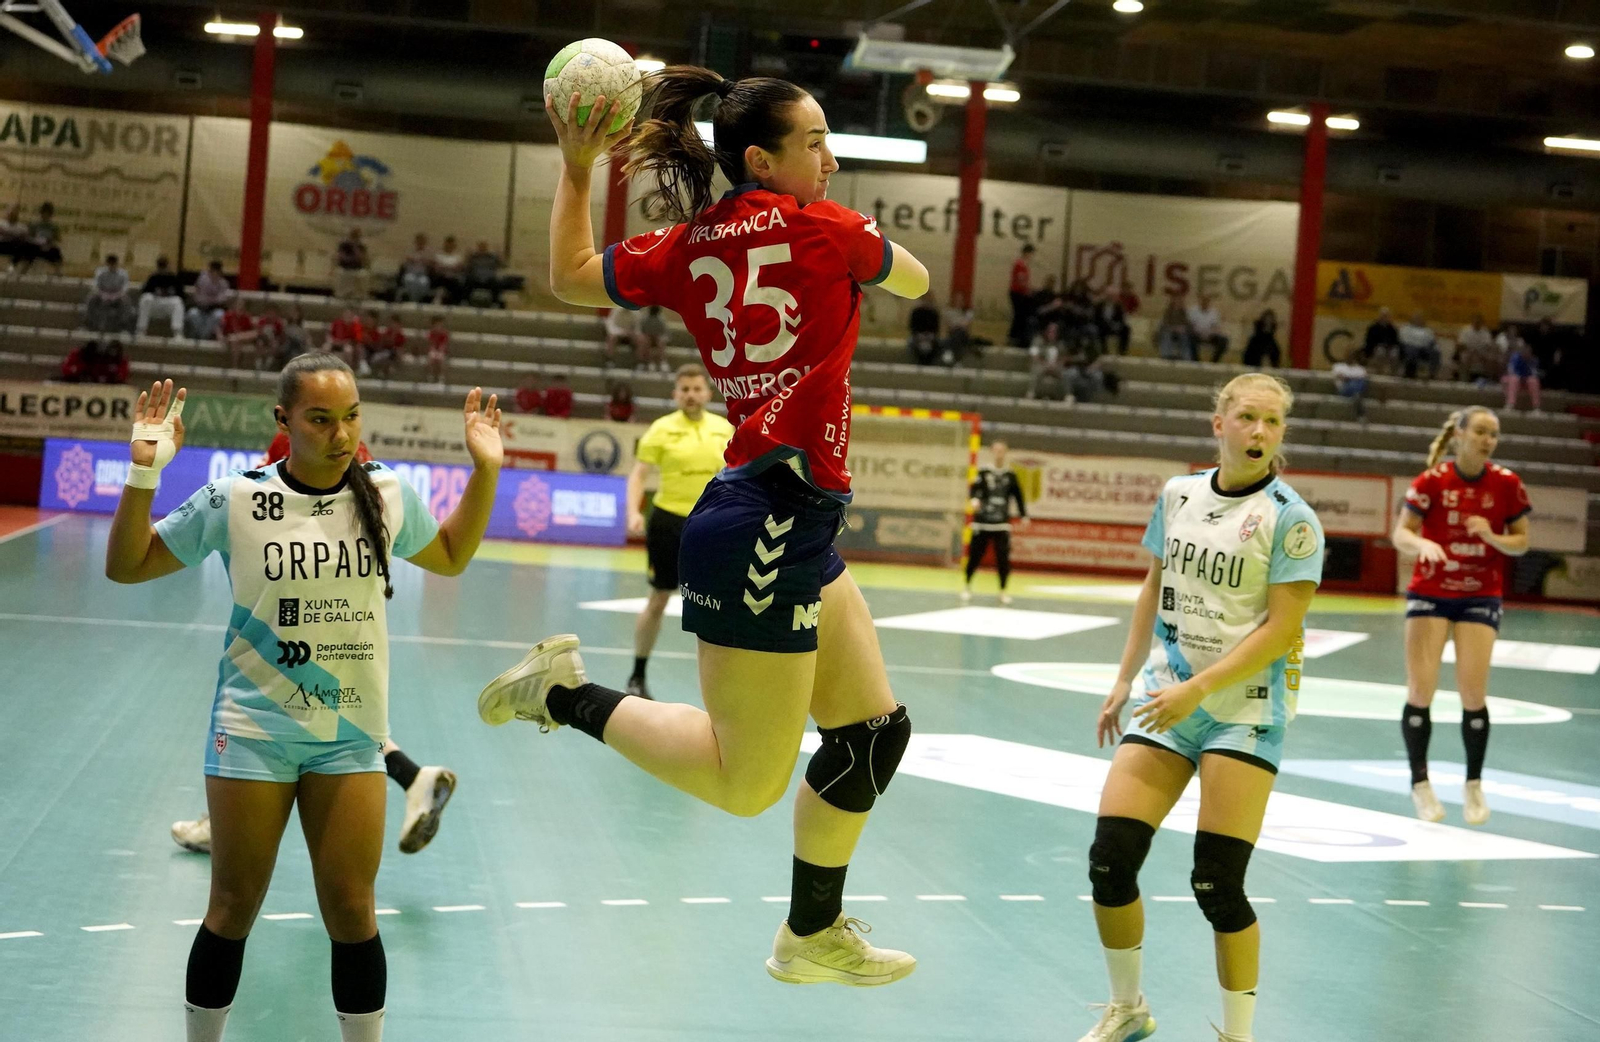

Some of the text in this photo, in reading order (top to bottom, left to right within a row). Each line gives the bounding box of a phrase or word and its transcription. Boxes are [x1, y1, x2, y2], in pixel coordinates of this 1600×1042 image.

[295, 183, 399, 221] ORBE
[873, 197, 1054, 242] tecflter
[1145, 254, 1292, 302] ISEGA
[689, 243, 801, 368] 35
[252, 491, 284, 521] 38
[311, 508, 334, 517] ZICO
[304, 599, 350, 611] XUNTA
[303, 611, 375, 624] DE GALICIA
[1183, 605, 1225, 621] GALICIA
[316, 641, 374, 653] Deputación
[316, 652, 374, 662] Pontevedra
[321, 687, 356, 698] MONTE
[332, 695, 362, 704] TECLA
